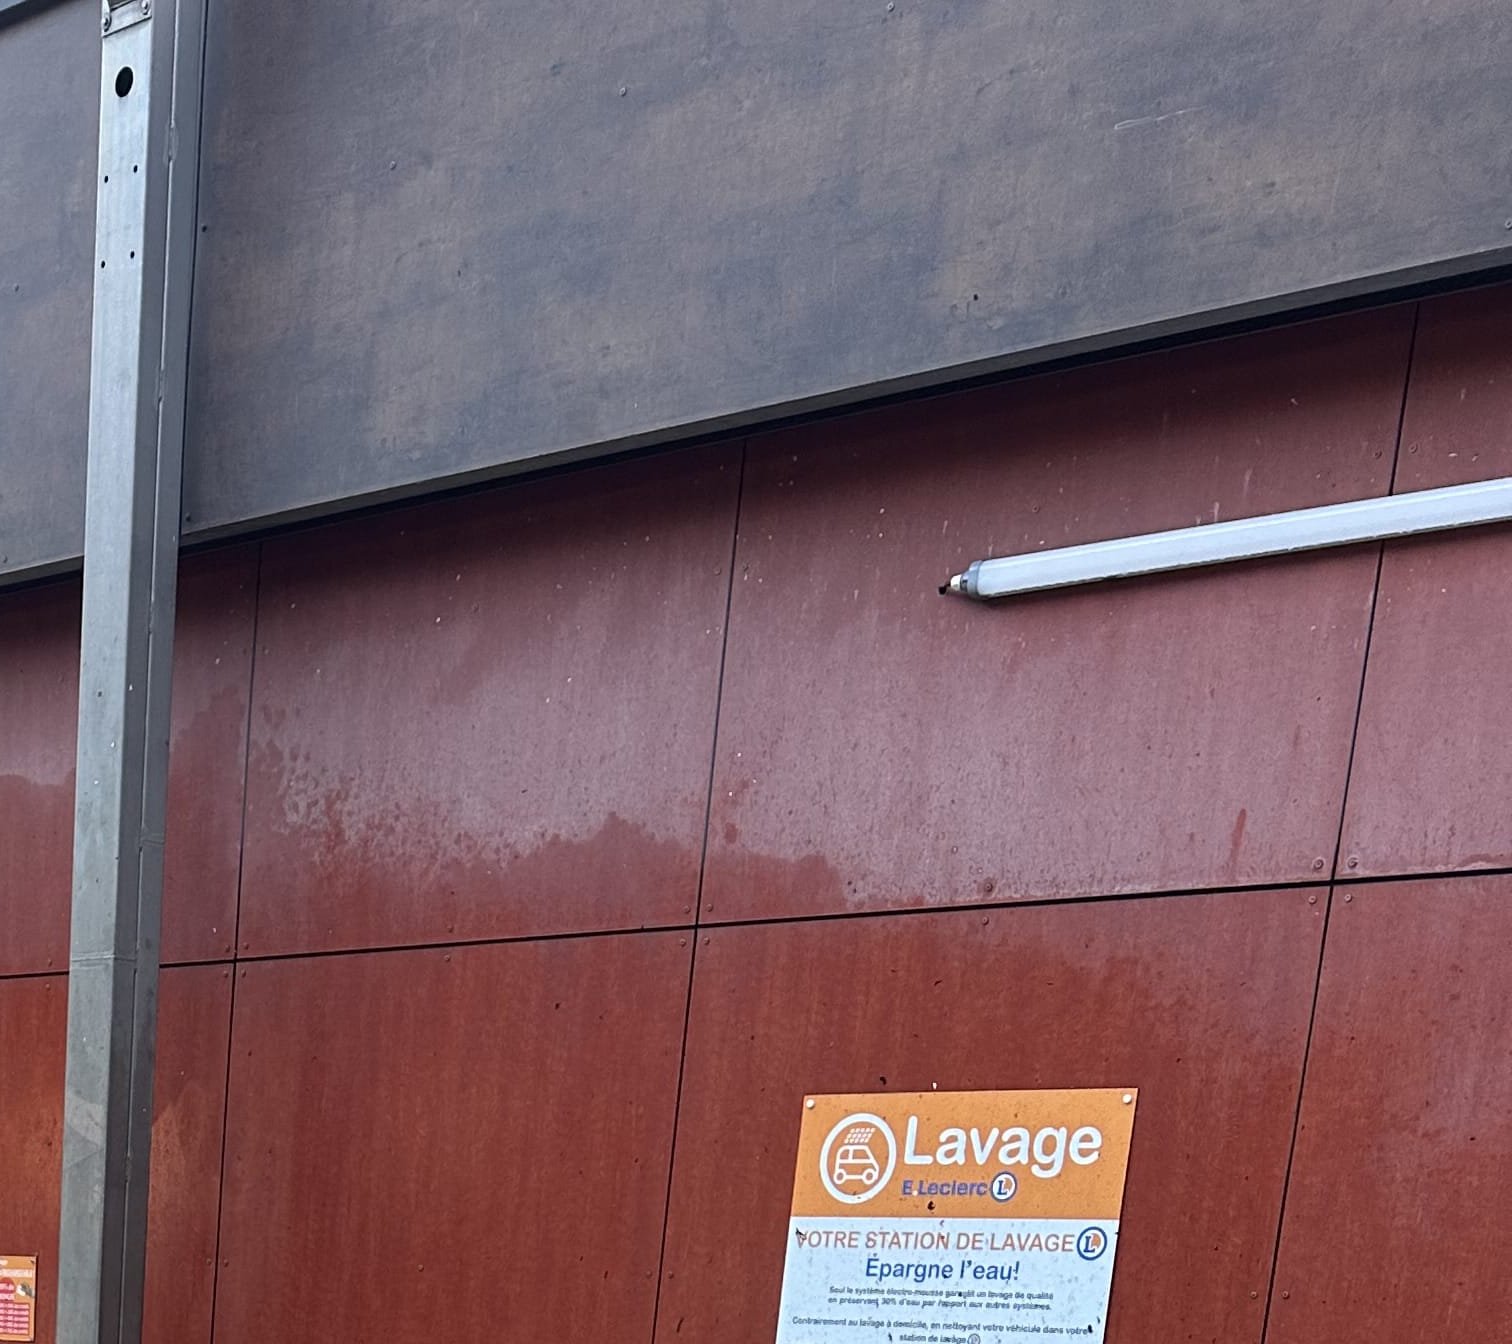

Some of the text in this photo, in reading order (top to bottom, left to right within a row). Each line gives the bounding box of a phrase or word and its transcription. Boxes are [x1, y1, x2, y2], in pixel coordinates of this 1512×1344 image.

[904, 1115, 1102, 1179] Lavage
[902, 1180, 987, 1197] E.Leclerc
[796, 1231, 860, 1249] VOTRE
[865, 1231, 950, 1250] STATION
[956, 1232, 984, 1250] DE
[990, 1233, 1075, 1252] LAVAGE
[866, 1253, 953, 1283] Épargne
